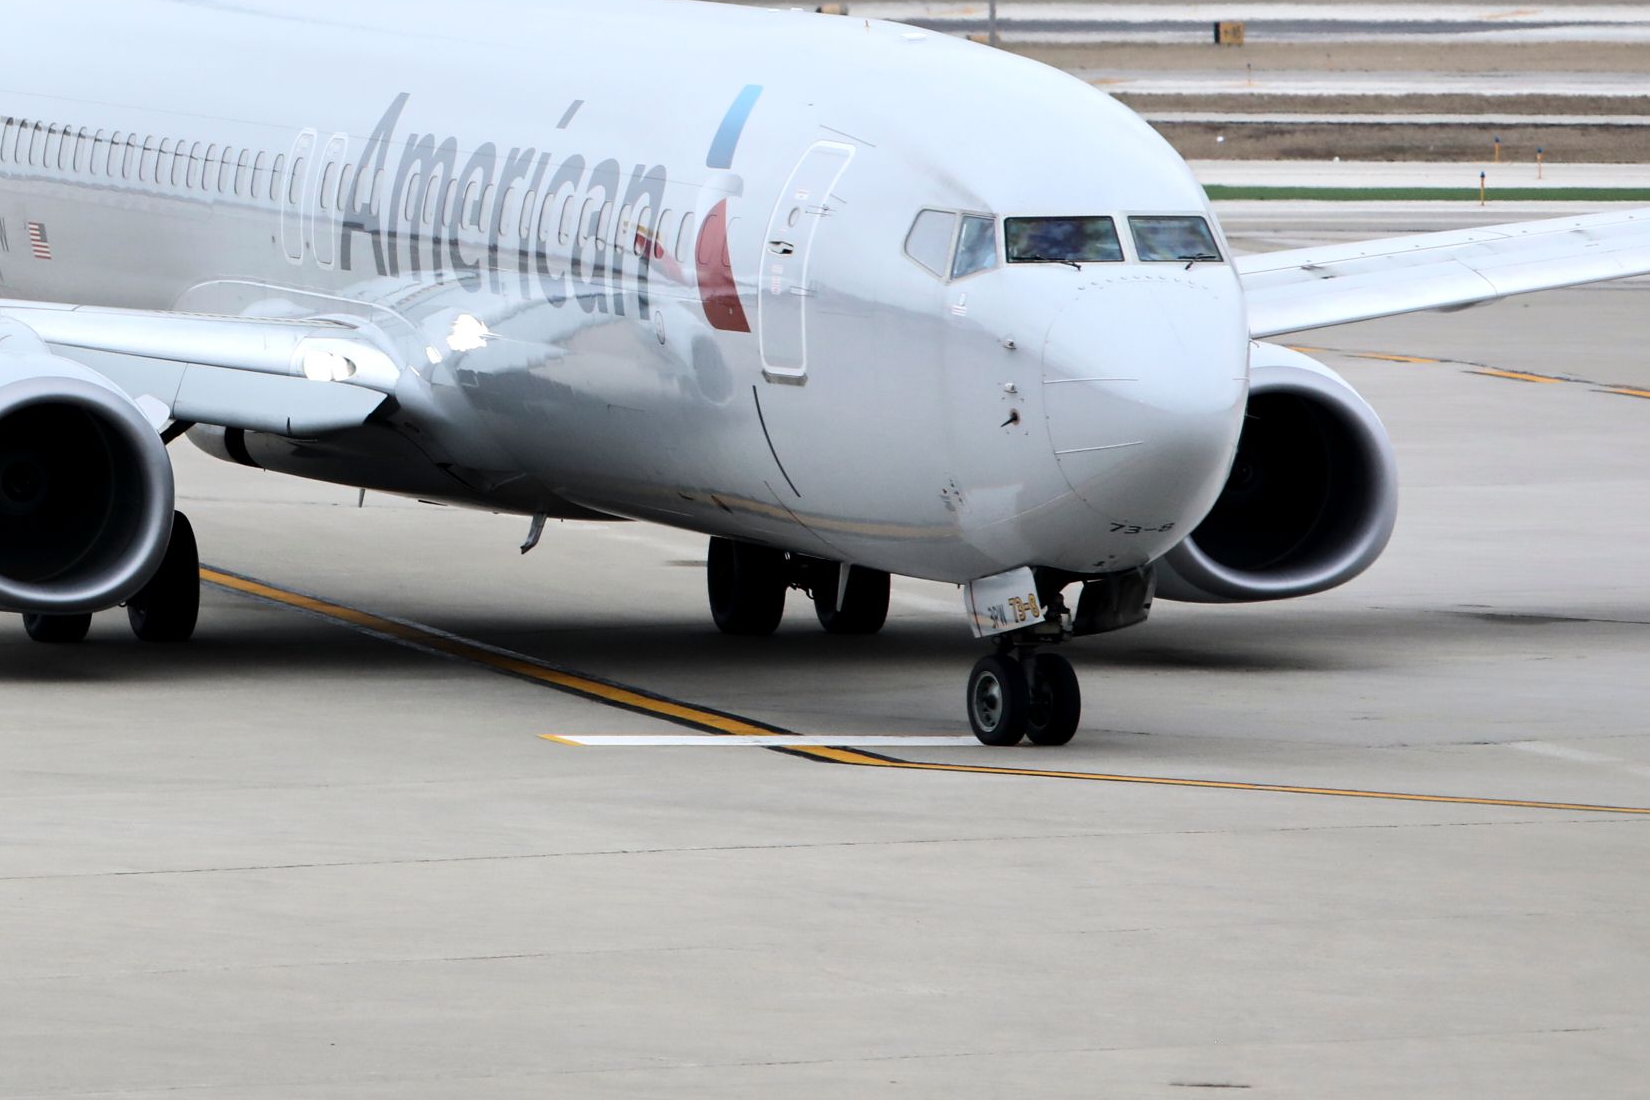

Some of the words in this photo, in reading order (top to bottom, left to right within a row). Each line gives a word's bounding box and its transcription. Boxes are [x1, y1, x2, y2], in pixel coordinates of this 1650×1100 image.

[341, 92, 667, 321] American
[1109, 522, 1175, 535] 73-8
[1008, 593, 1041, 623] 73-8
